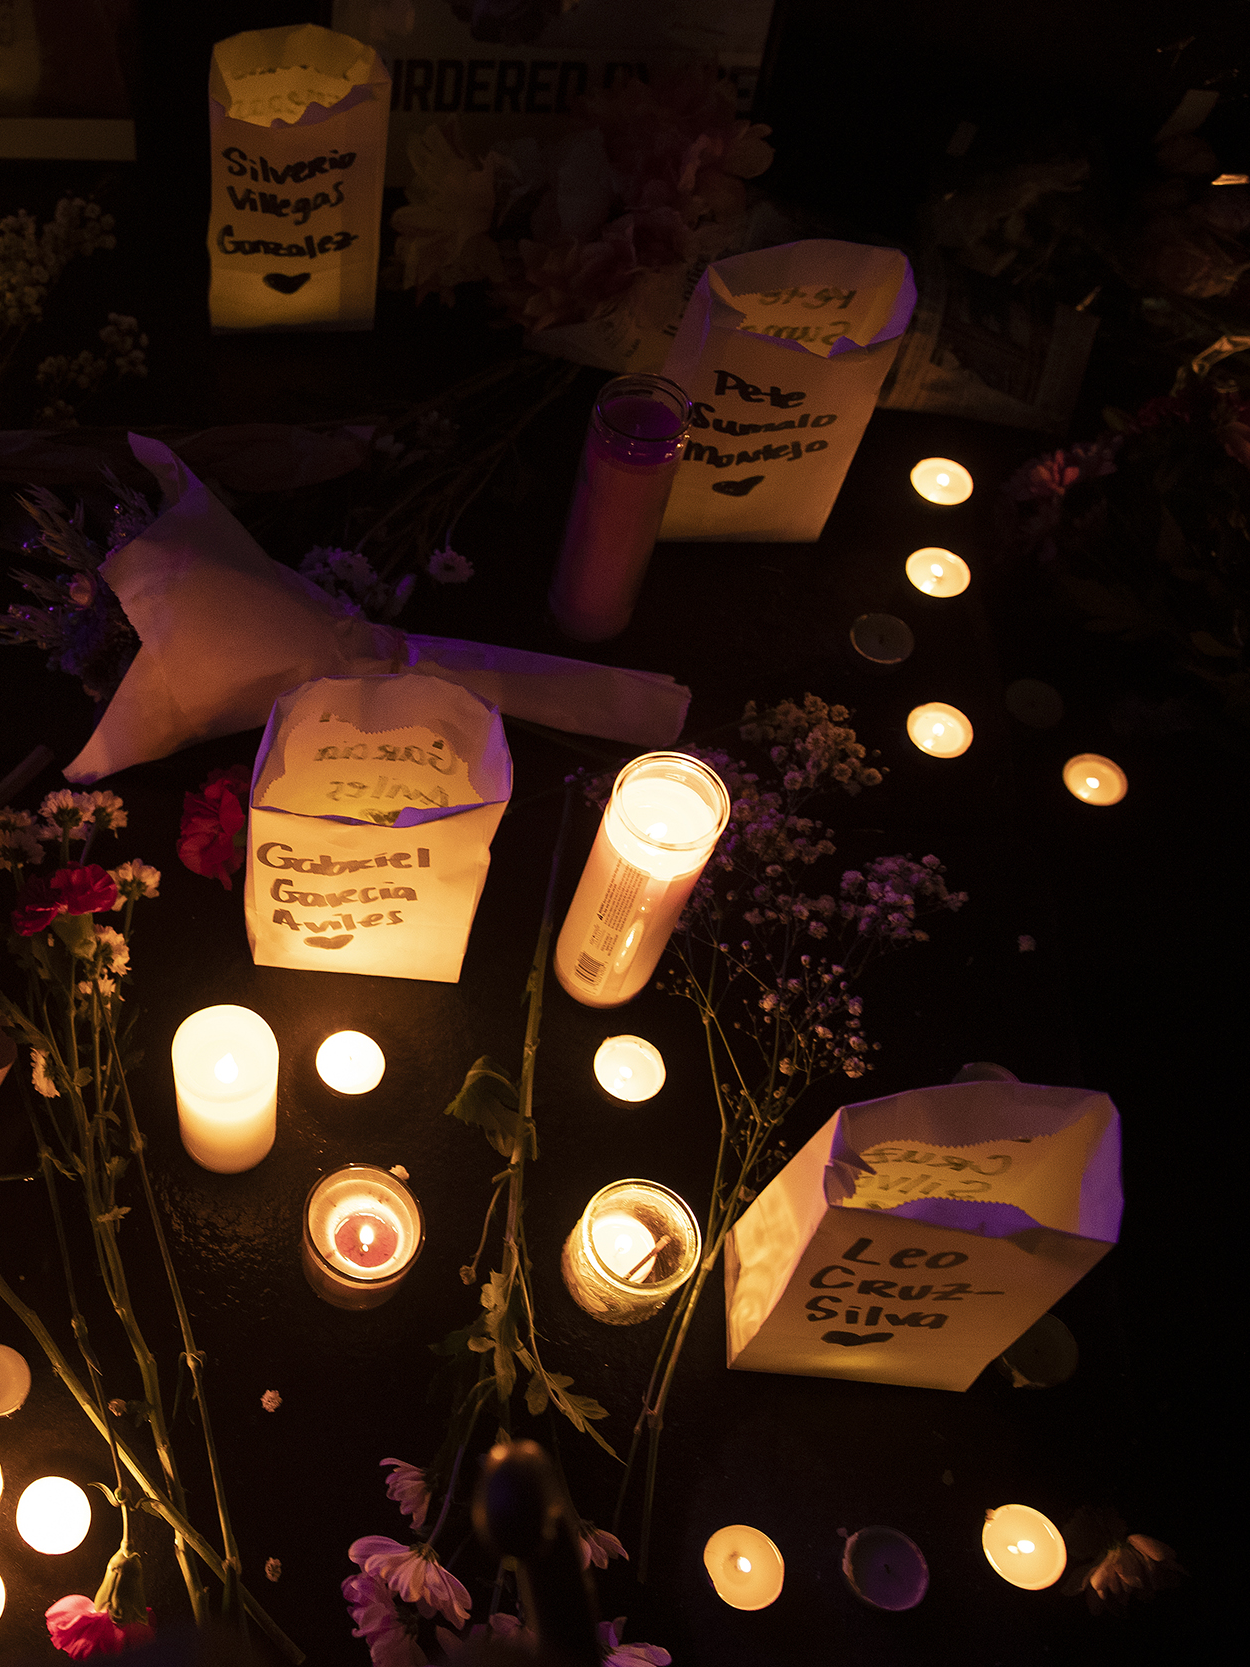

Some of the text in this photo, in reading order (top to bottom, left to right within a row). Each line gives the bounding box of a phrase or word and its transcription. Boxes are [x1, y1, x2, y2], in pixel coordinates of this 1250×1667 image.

[222, 147, 356, 184] Silverio
[227, 181, 344, 225] Villegas
[217, 225, 358, 259] Gonzalez
[714, 370, 806, 409] Pete
[692, 402, 837, 436] Sumalo
[272, 908, 404, 933] Aviles
[842, 1237, 969, 1269] Leo
[805, 1295, 949, 1329] Silva
